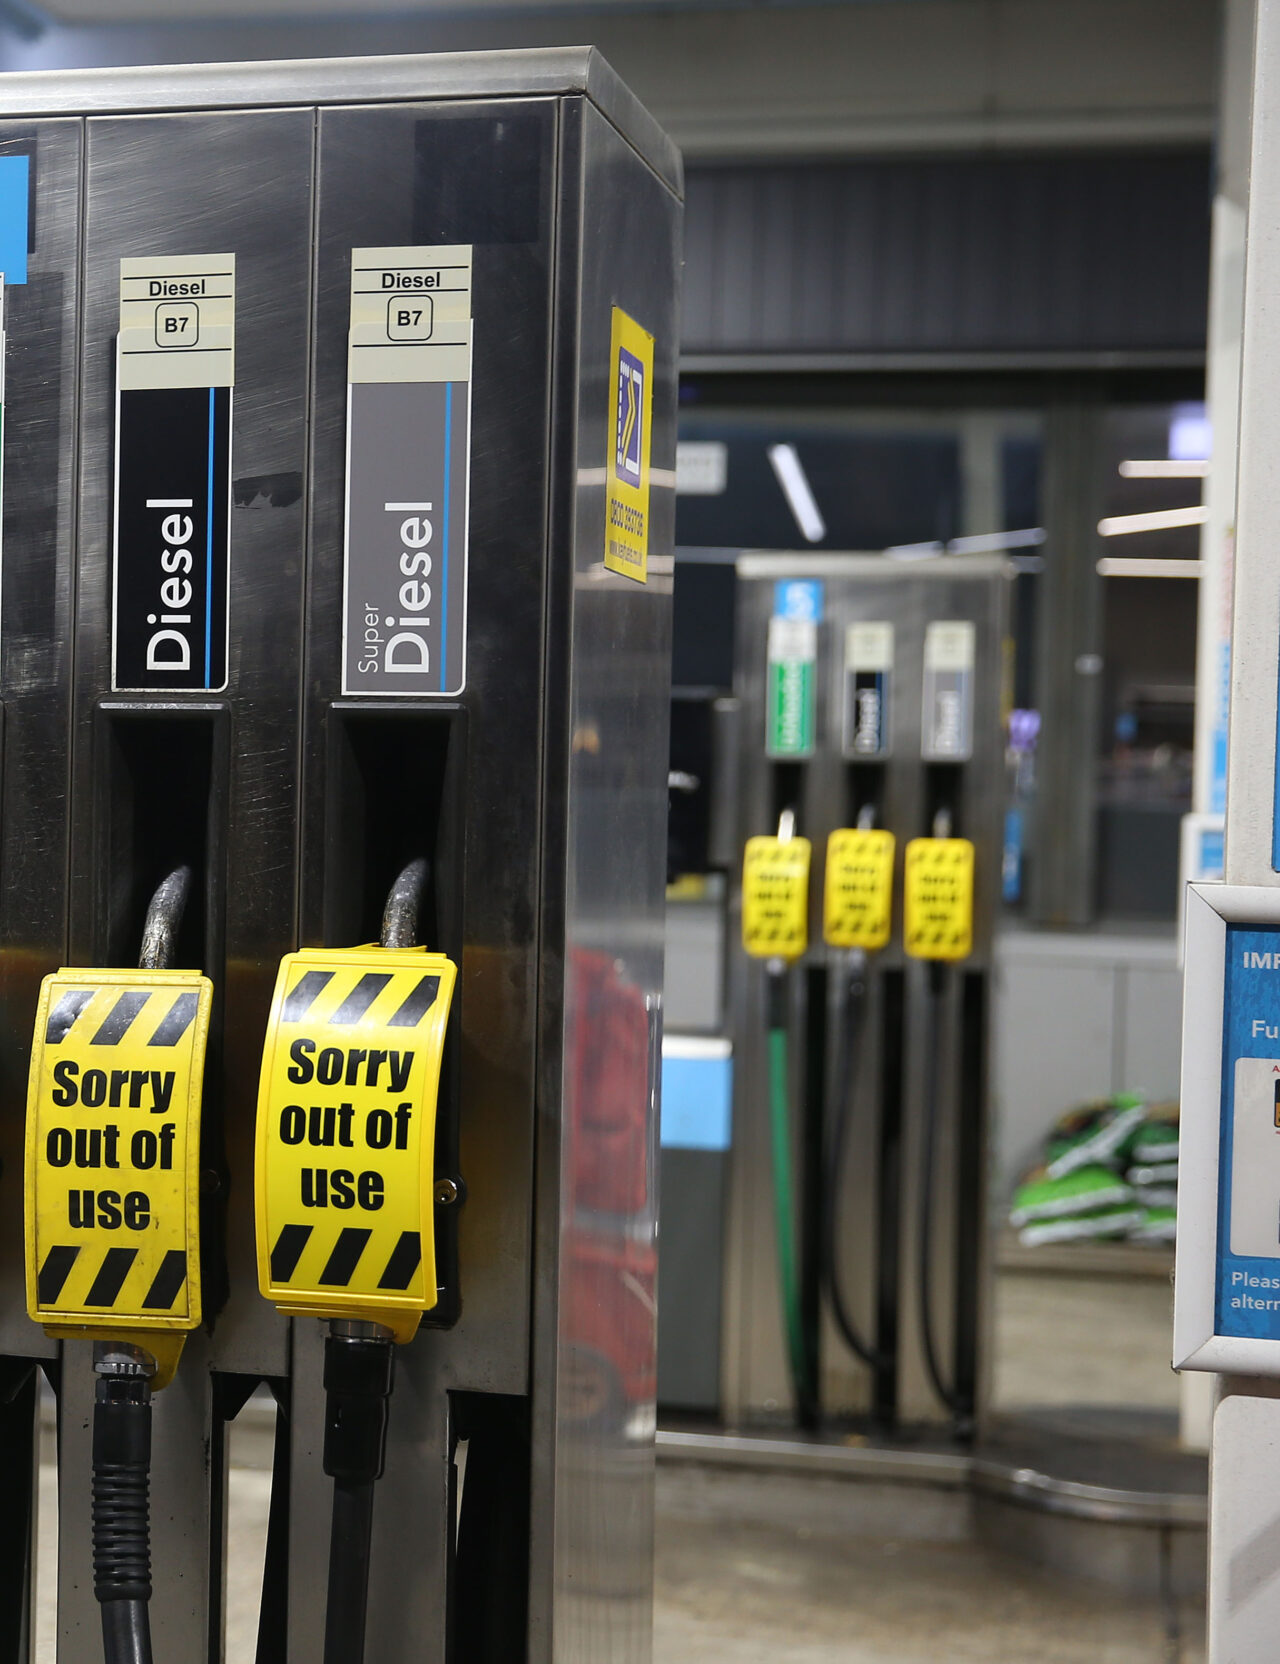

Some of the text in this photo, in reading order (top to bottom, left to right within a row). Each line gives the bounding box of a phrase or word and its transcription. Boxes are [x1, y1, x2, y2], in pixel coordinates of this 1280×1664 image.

[148, 278, 206, 297] Diesel
[381, 272, 441, 290] Diesel
[163, 317, 189, 333] B7
[397, 311, 424, 327] B7
[146, 498, 194, 671] Diesel
[384, 502, 433, 674] Diesel
[357, 602, 385, 674] Super
[51, 1060, 176, 1114] Sorry
[287, 1038, 415, 1093] Sorry
[46, 1123, 176, 1170] out of
[279, 1102, 413, 1150] out of
[68, 1189, 151, 1231] use
[300, 1167, 385, 1212] use
[1231, 1271, 1280, 1289] Pleas
